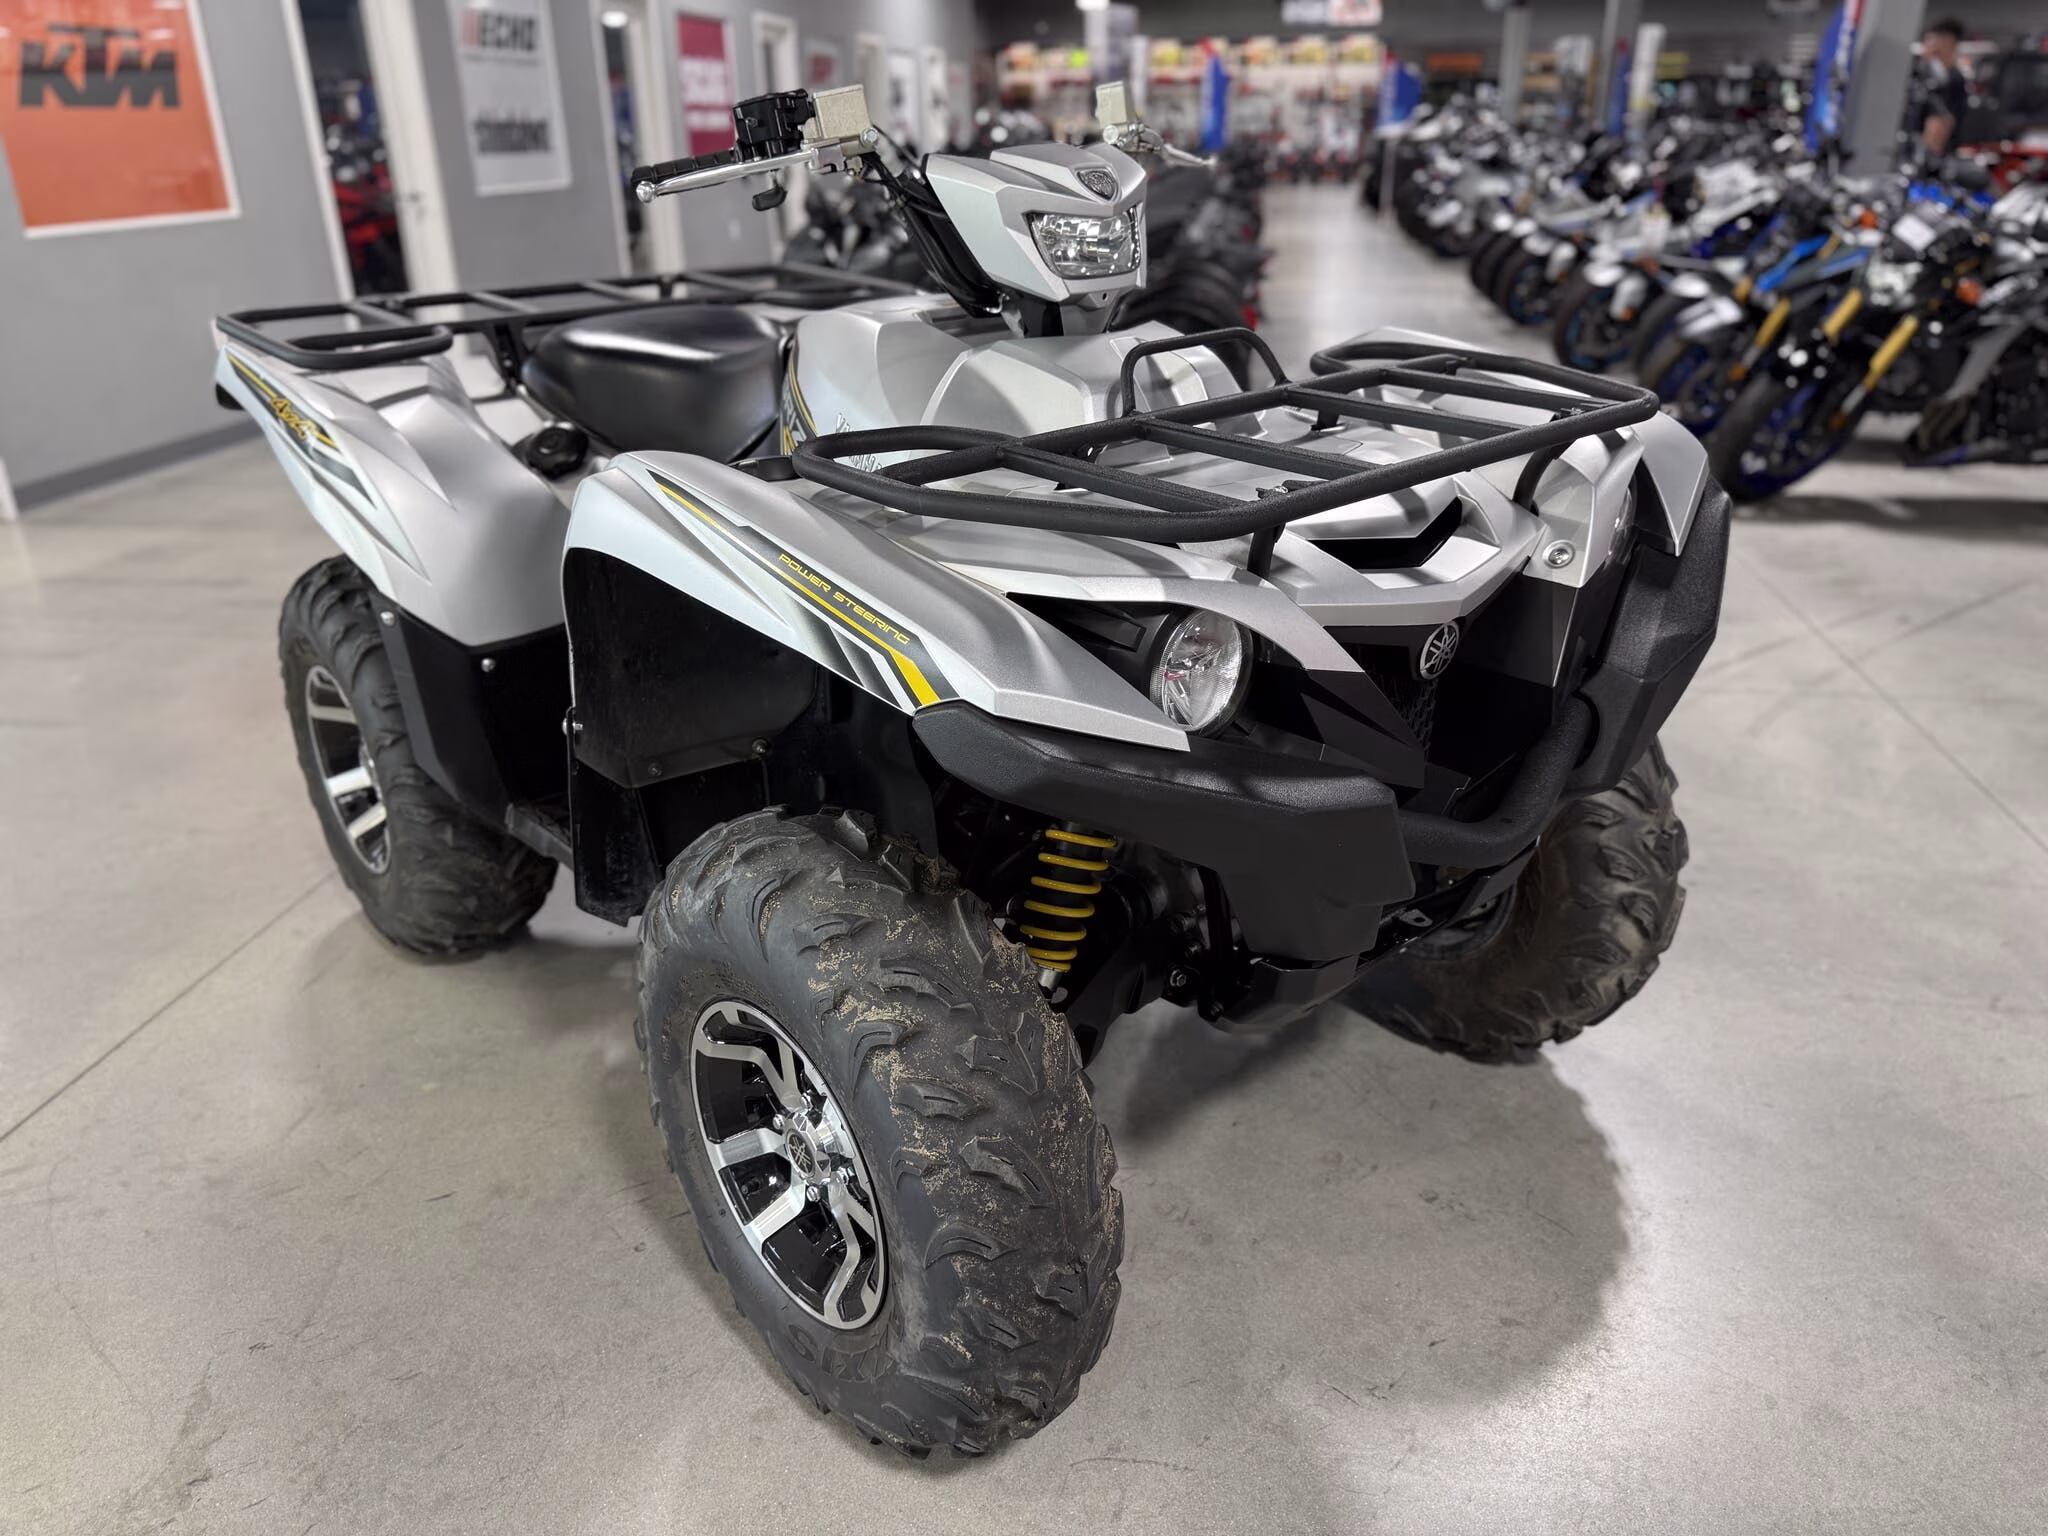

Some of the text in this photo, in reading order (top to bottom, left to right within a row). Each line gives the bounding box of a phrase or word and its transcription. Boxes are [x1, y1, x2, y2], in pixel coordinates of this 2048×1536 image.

[20, 22, 180, 109] KTM
[778, 553, 911, 645] POWER STEERING
